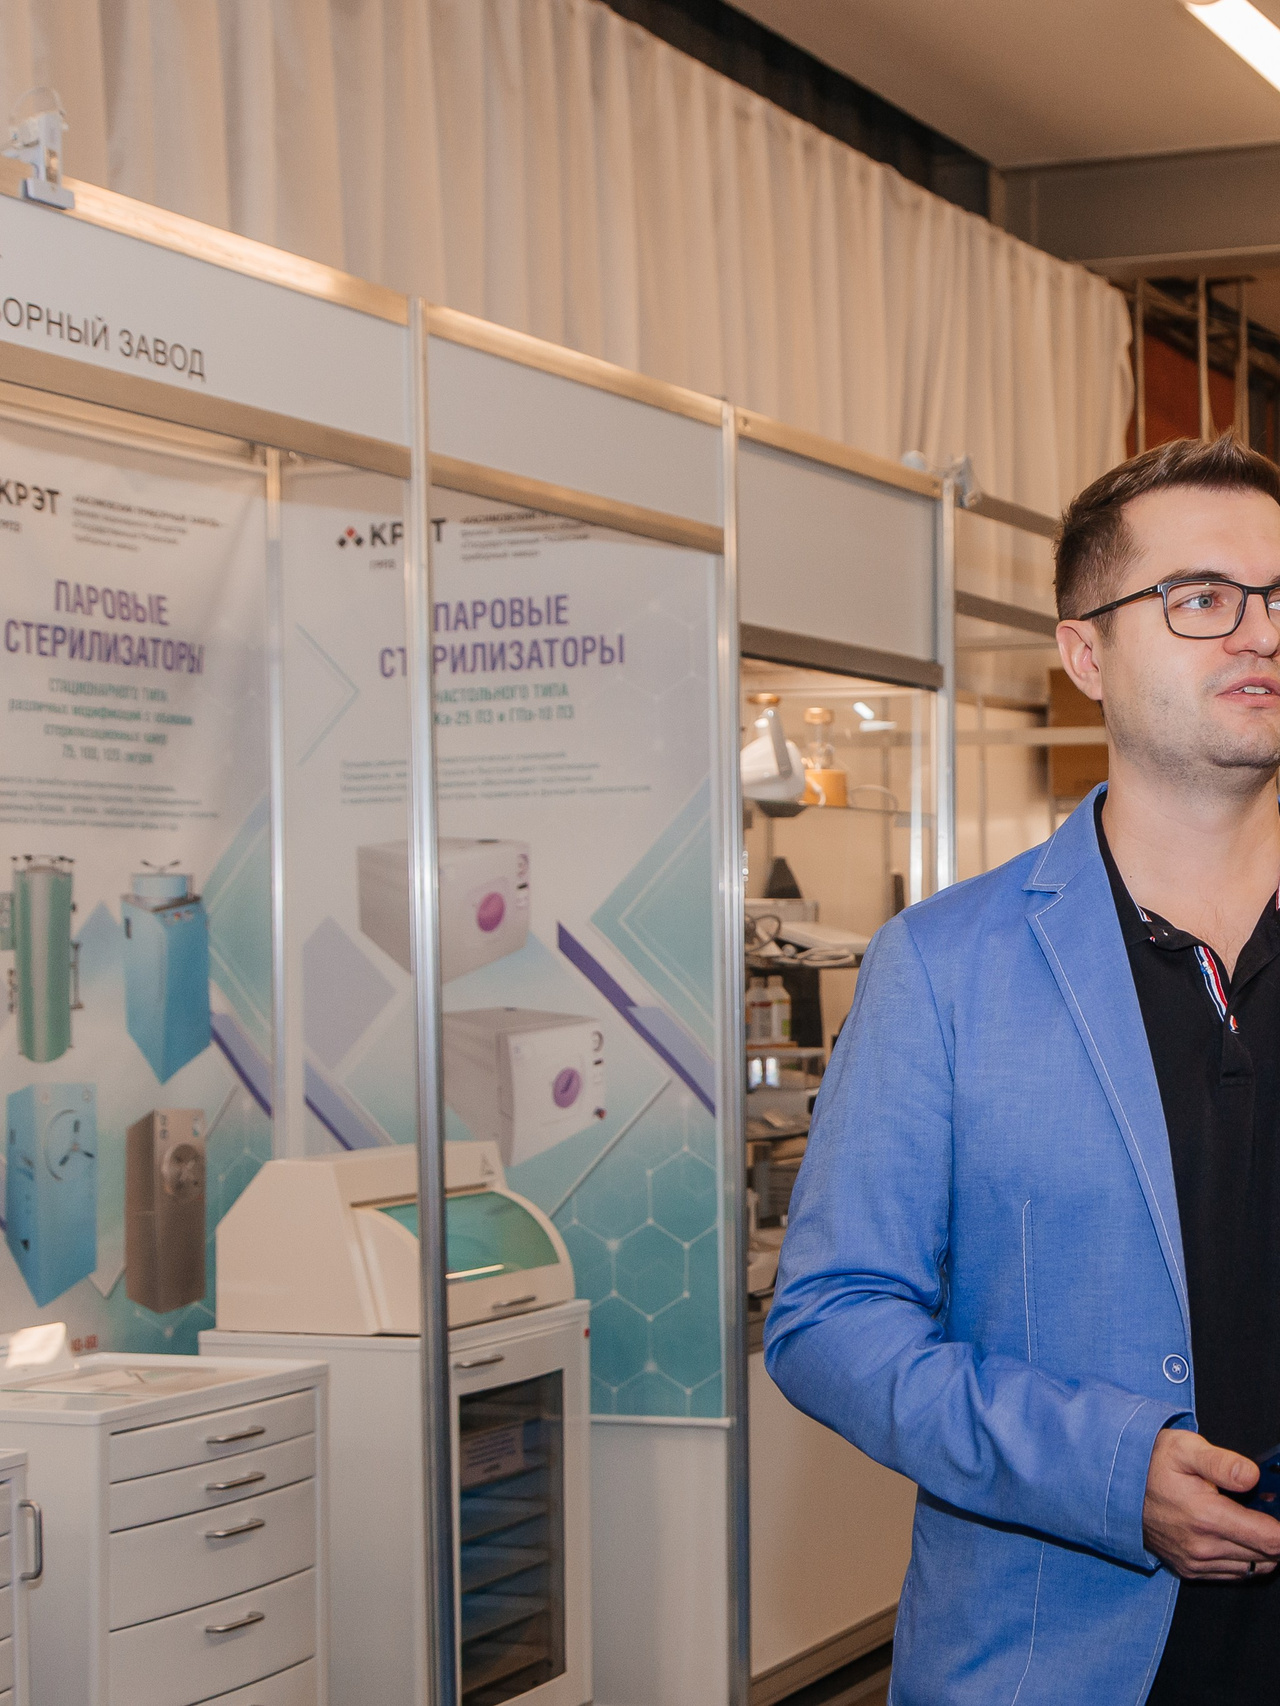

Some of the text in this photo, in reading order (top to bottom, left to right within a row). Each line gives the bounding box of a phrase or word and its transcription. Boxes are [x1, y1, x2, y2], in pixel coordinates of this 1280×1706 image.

[0, 297, 207, 382] ОРНЫЙ ЗАВОД
[370, 518, 447, 546] КРТ
[54, 579, 169, 626] ПАРОВЫЕ
[433, 594, 569, 632] ПАРОВЫЕ
[4, 618, 206, 675] СТЕРИЛИЗАТОРЫ
[379, 633, 625, 679] СТРИЛИЗАТОРЫ
